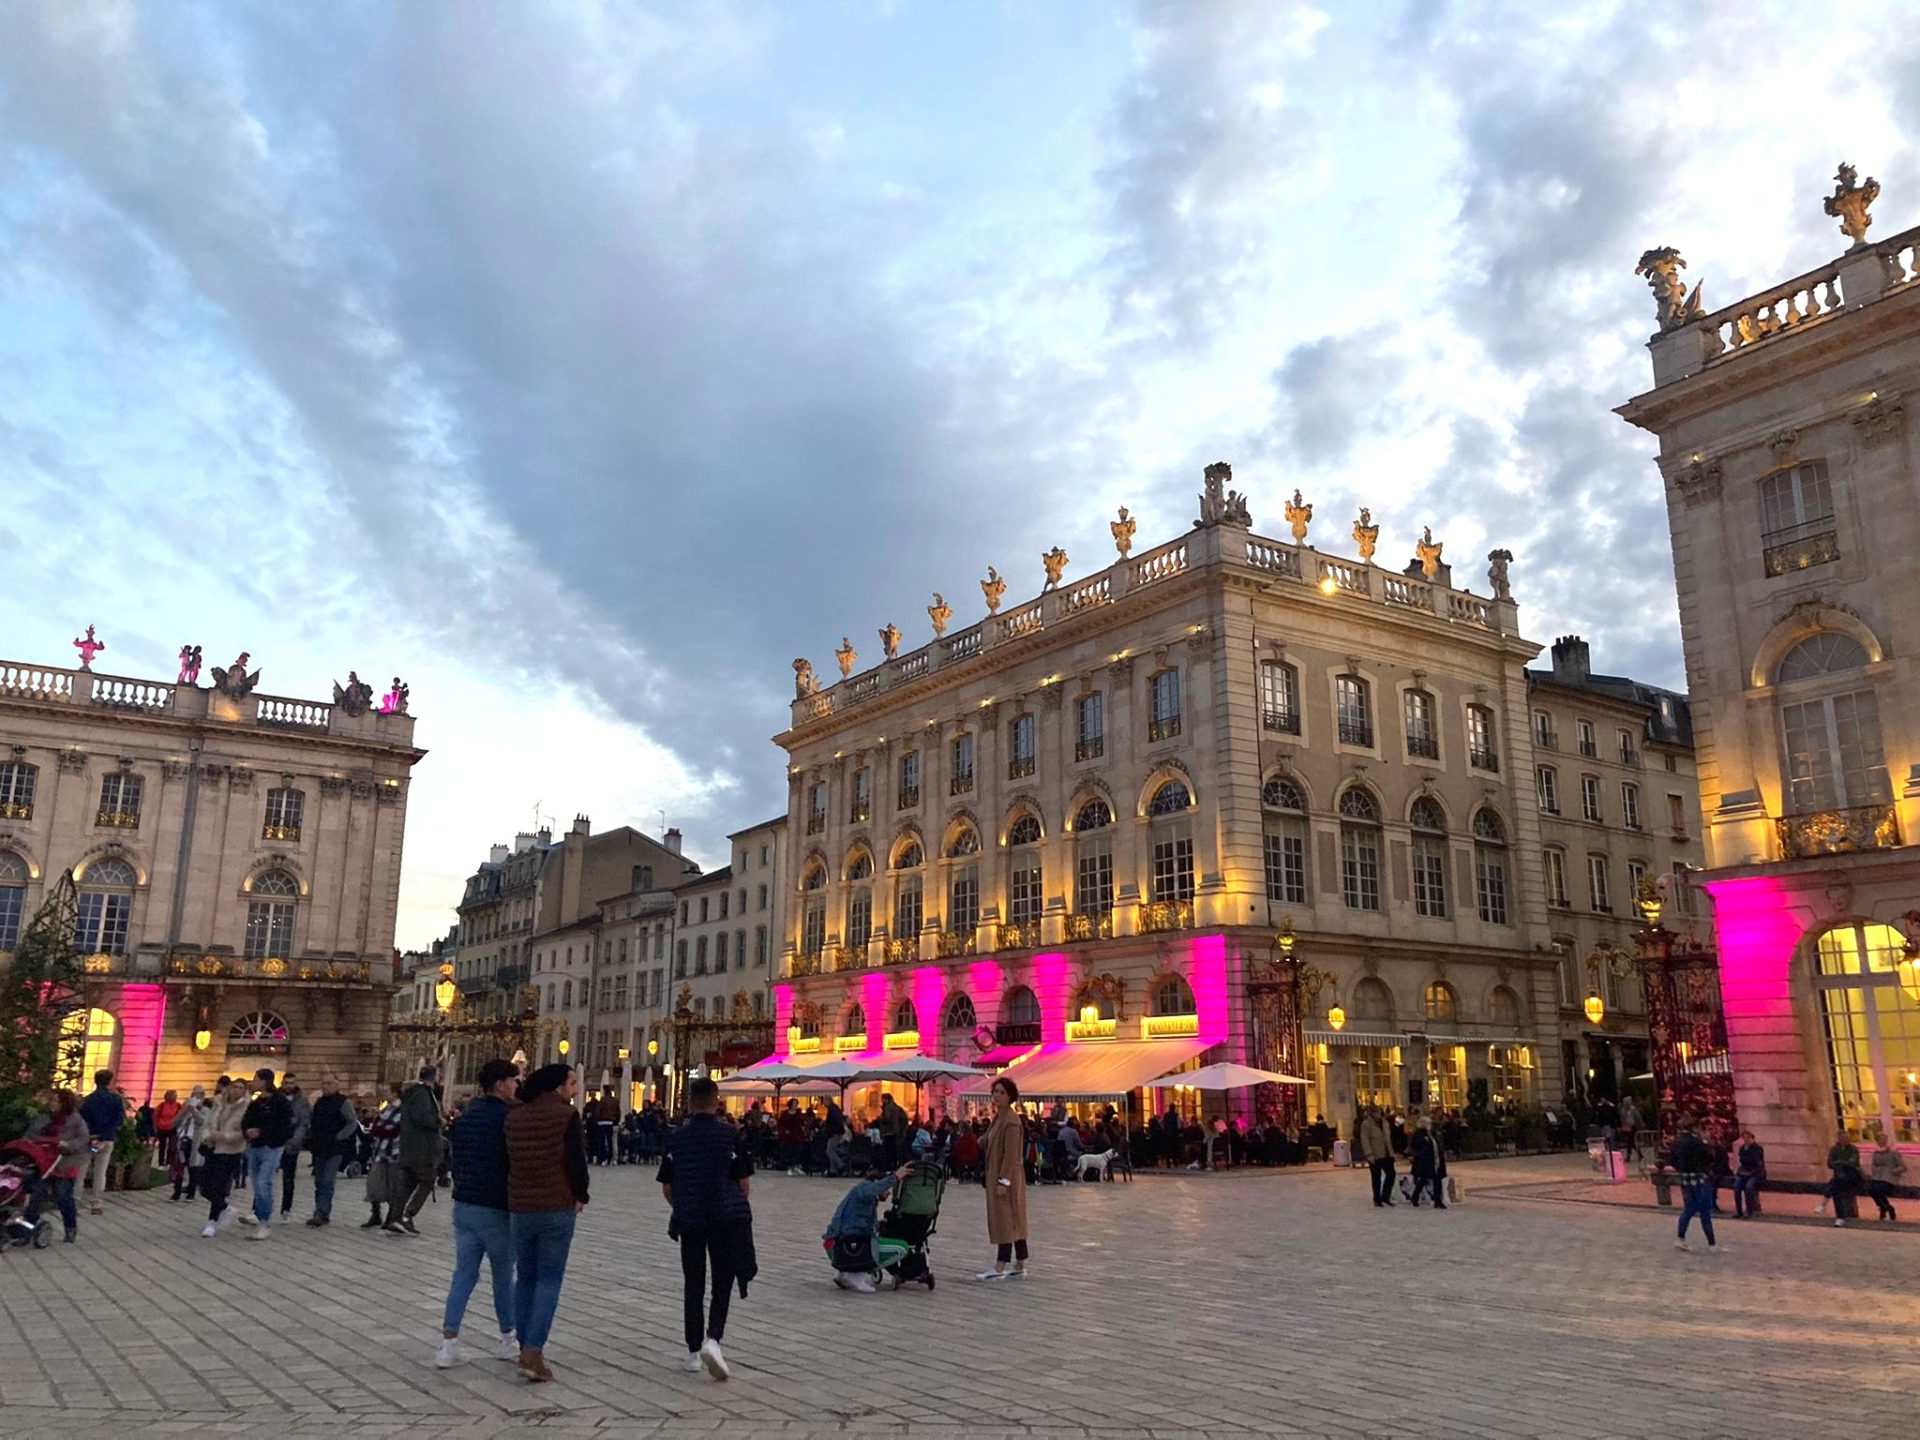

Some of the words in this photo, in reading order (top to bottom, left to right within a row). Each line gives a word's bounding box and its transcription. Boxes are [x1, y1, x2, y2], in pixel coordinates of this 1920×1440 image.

[1001, 1026, 1039, 1041] TABAC
[1100, 1024, 1113, 1035] DU
[1149, 1019, 1198, 1034] COMMERCE
